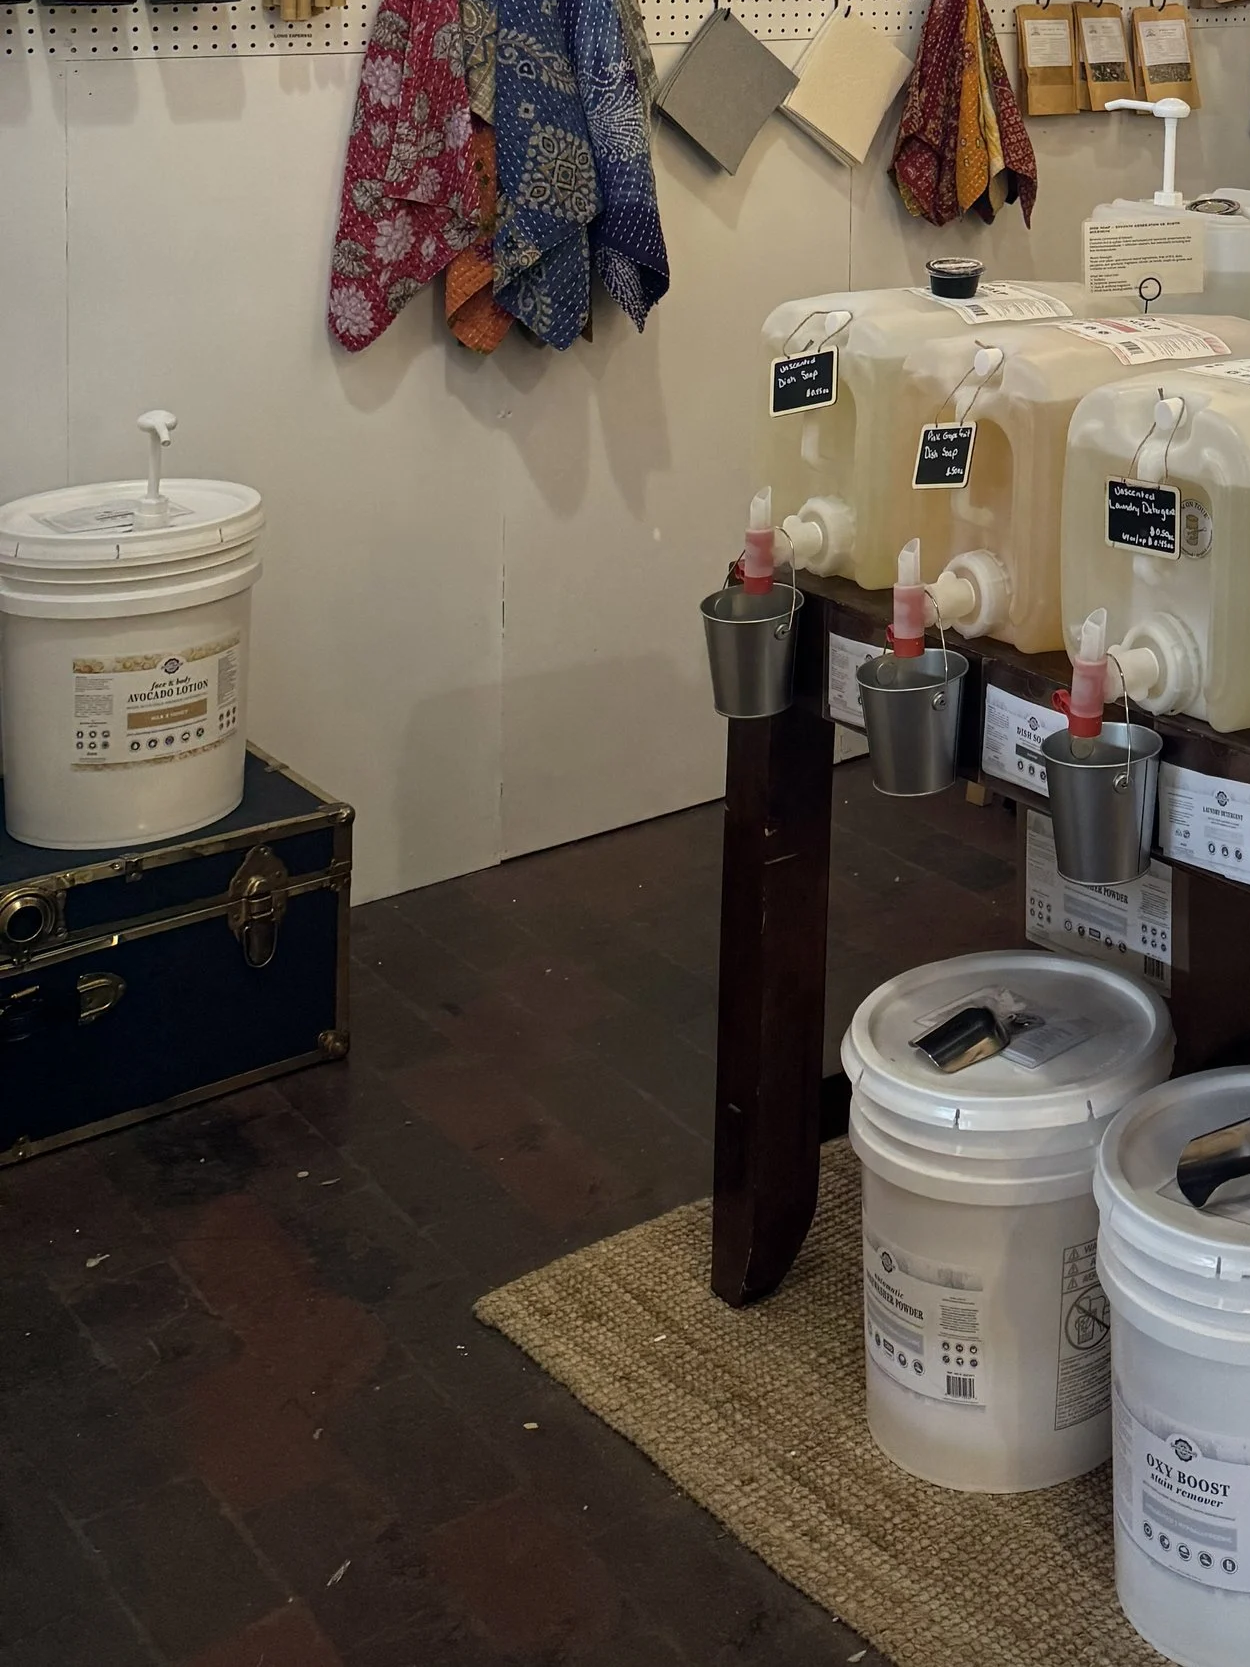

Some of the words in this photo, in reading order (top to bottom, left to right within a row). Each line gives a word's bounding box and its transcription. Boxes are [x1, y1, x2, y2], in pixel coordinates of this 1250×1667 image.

[779, 357, 816, 374] Unscented
[778, 374, 796, 388] Dish
[800, 370, 818, 381] Soap
[924, 446, 939, 459] Dish
[941, 447, 958, 459] Soap
[1114, 486, 1156, 501] Unscented
[1108, 499, 1140, 516] Laundry
[127, 688, 174, 703] AVOCADO
[176, 679, 209, 696] LOTION
[151, 680, 167, 691] face
[175, 676, 192, 685] body
[1016, 726, 1034, 740] DISH
[1202, 806, 1220, 817] LAUNDRY
[1221, 811, 1243, 821] DETERGENT
[1103, 887, 1129, 904] POWDER
[874, 1273, 904, 1299] automatic
[895, 1300, 924, 1320] POWDER
[1146, 1453, 1174, 1479] OXY
[1177, 1470, 1231, 1497] BOOST
[1150, 1472, 1173, 1491] stain
[1175, 1485, 1224, 1509] remover
